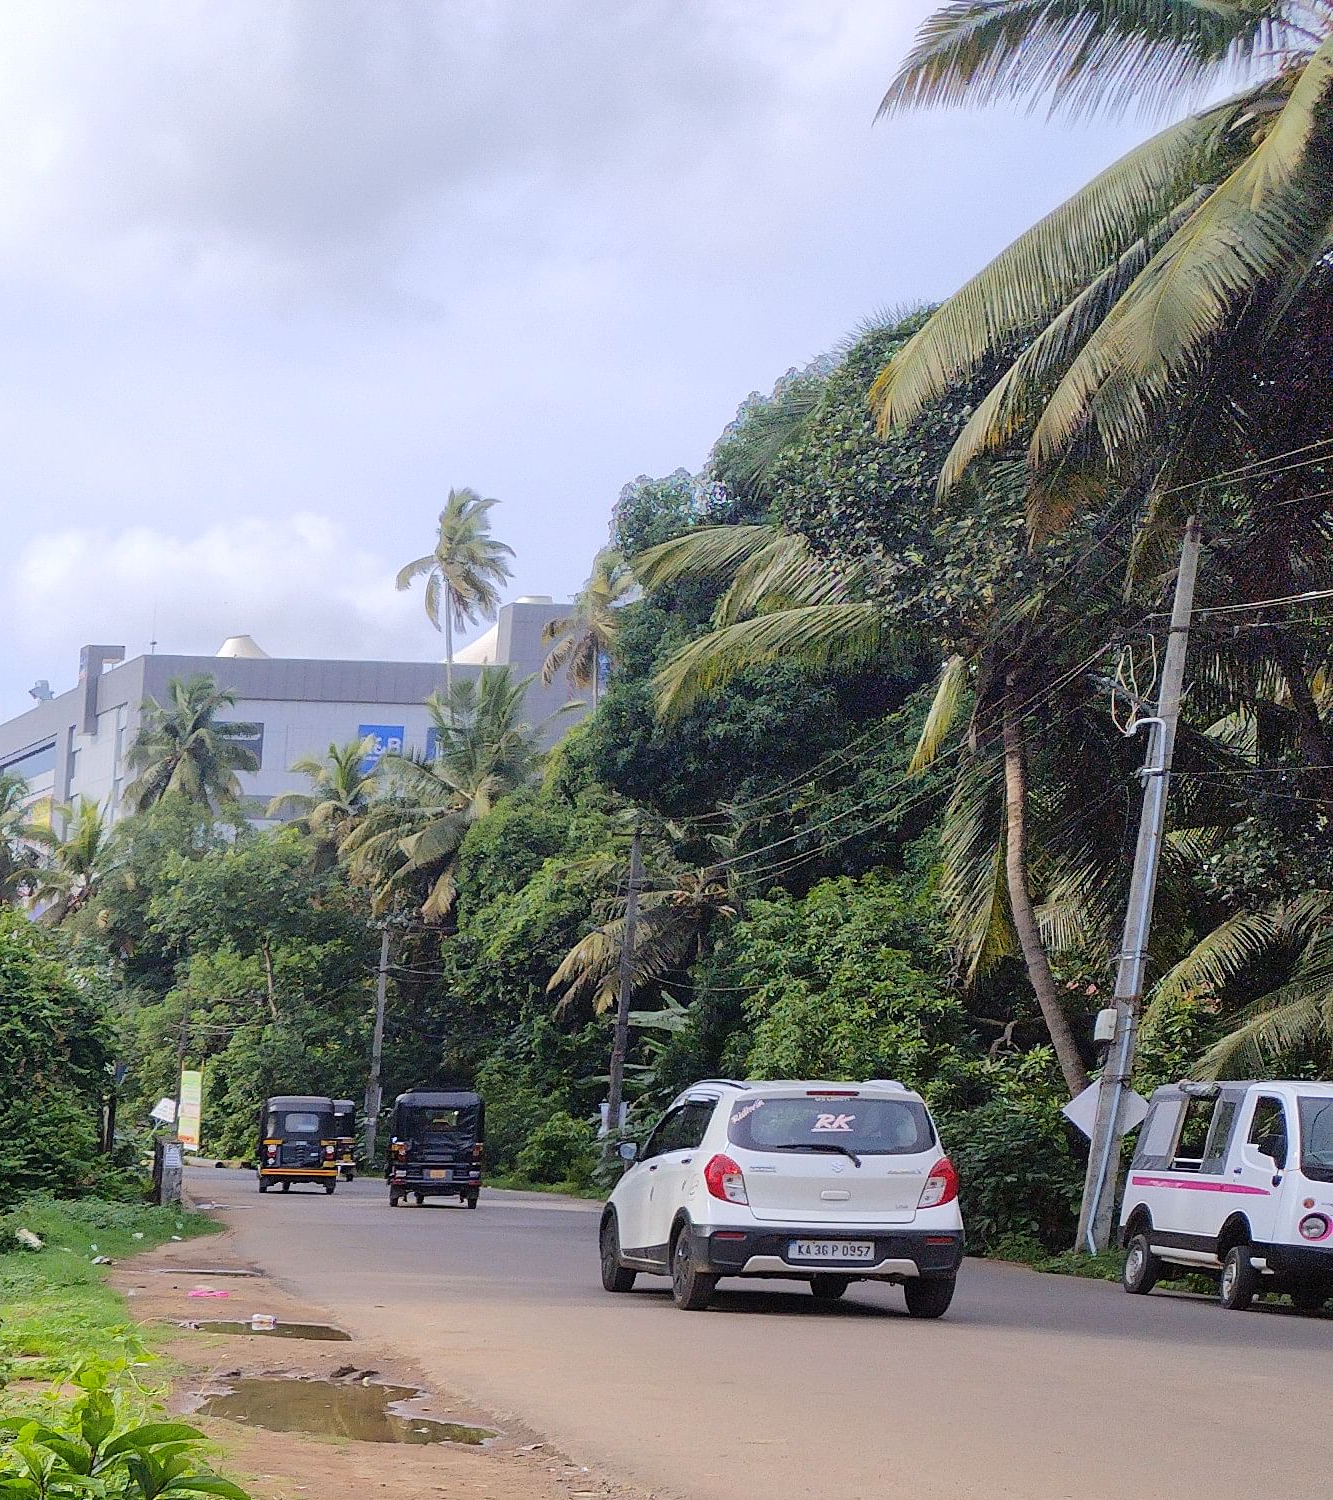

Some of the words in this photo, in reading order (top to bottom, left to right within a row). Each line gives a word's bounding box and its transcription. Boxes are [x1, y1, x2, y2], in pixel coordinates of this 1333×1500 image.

[814, 1113, 856, 1129] RK
[797, 1244, 811, 1256] KA
[832, 1244, 839, 1256] P
